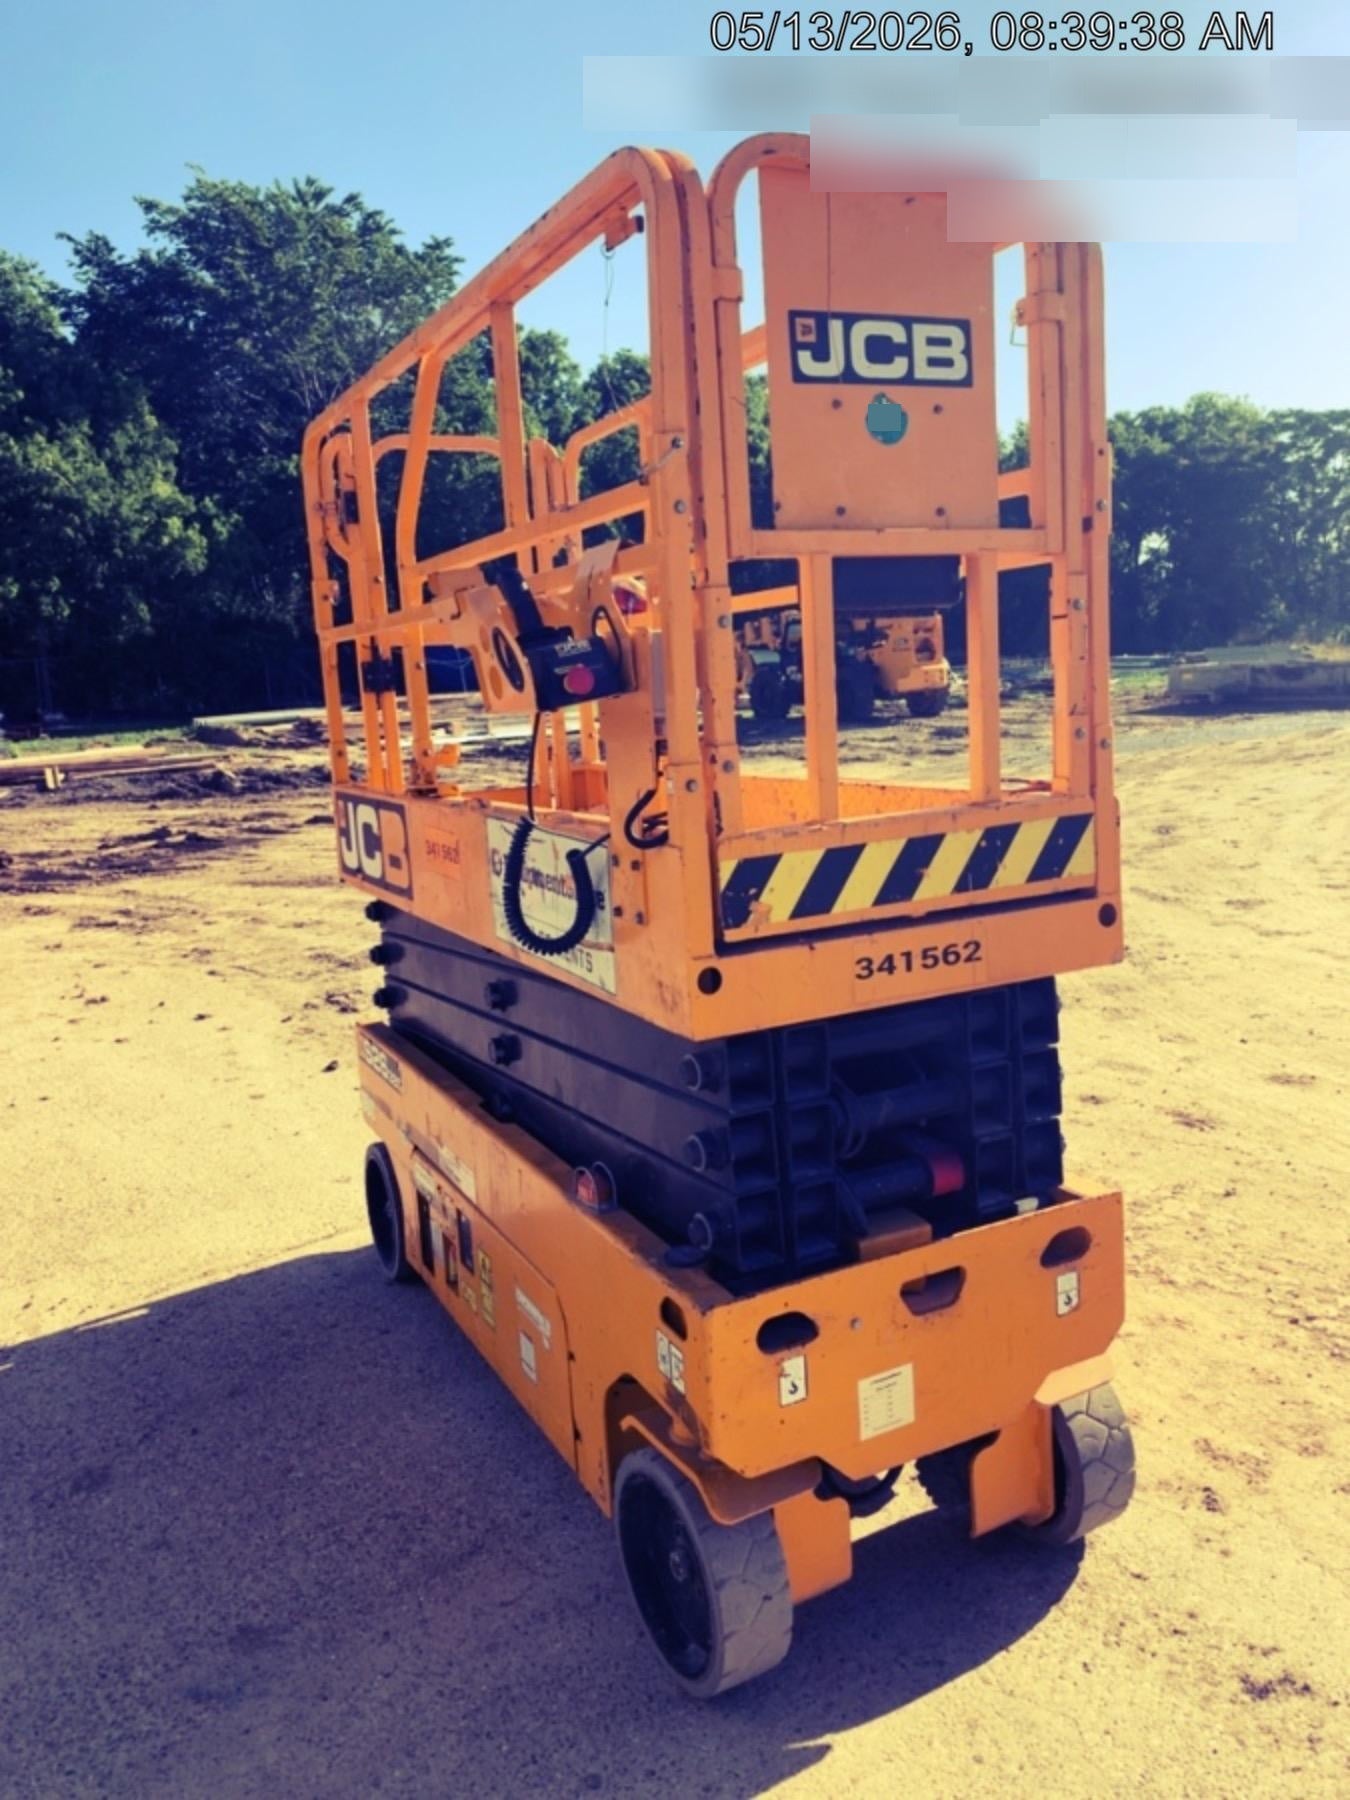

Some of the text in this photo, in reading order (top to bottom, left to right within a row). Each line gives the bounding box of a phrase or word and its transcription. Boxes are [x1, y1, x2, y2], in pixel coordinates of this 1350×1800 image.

[796, 318, 969, 381] JCB
[337, 800, 410, 890] JCB
[854, 939, 983, 981] 341562
